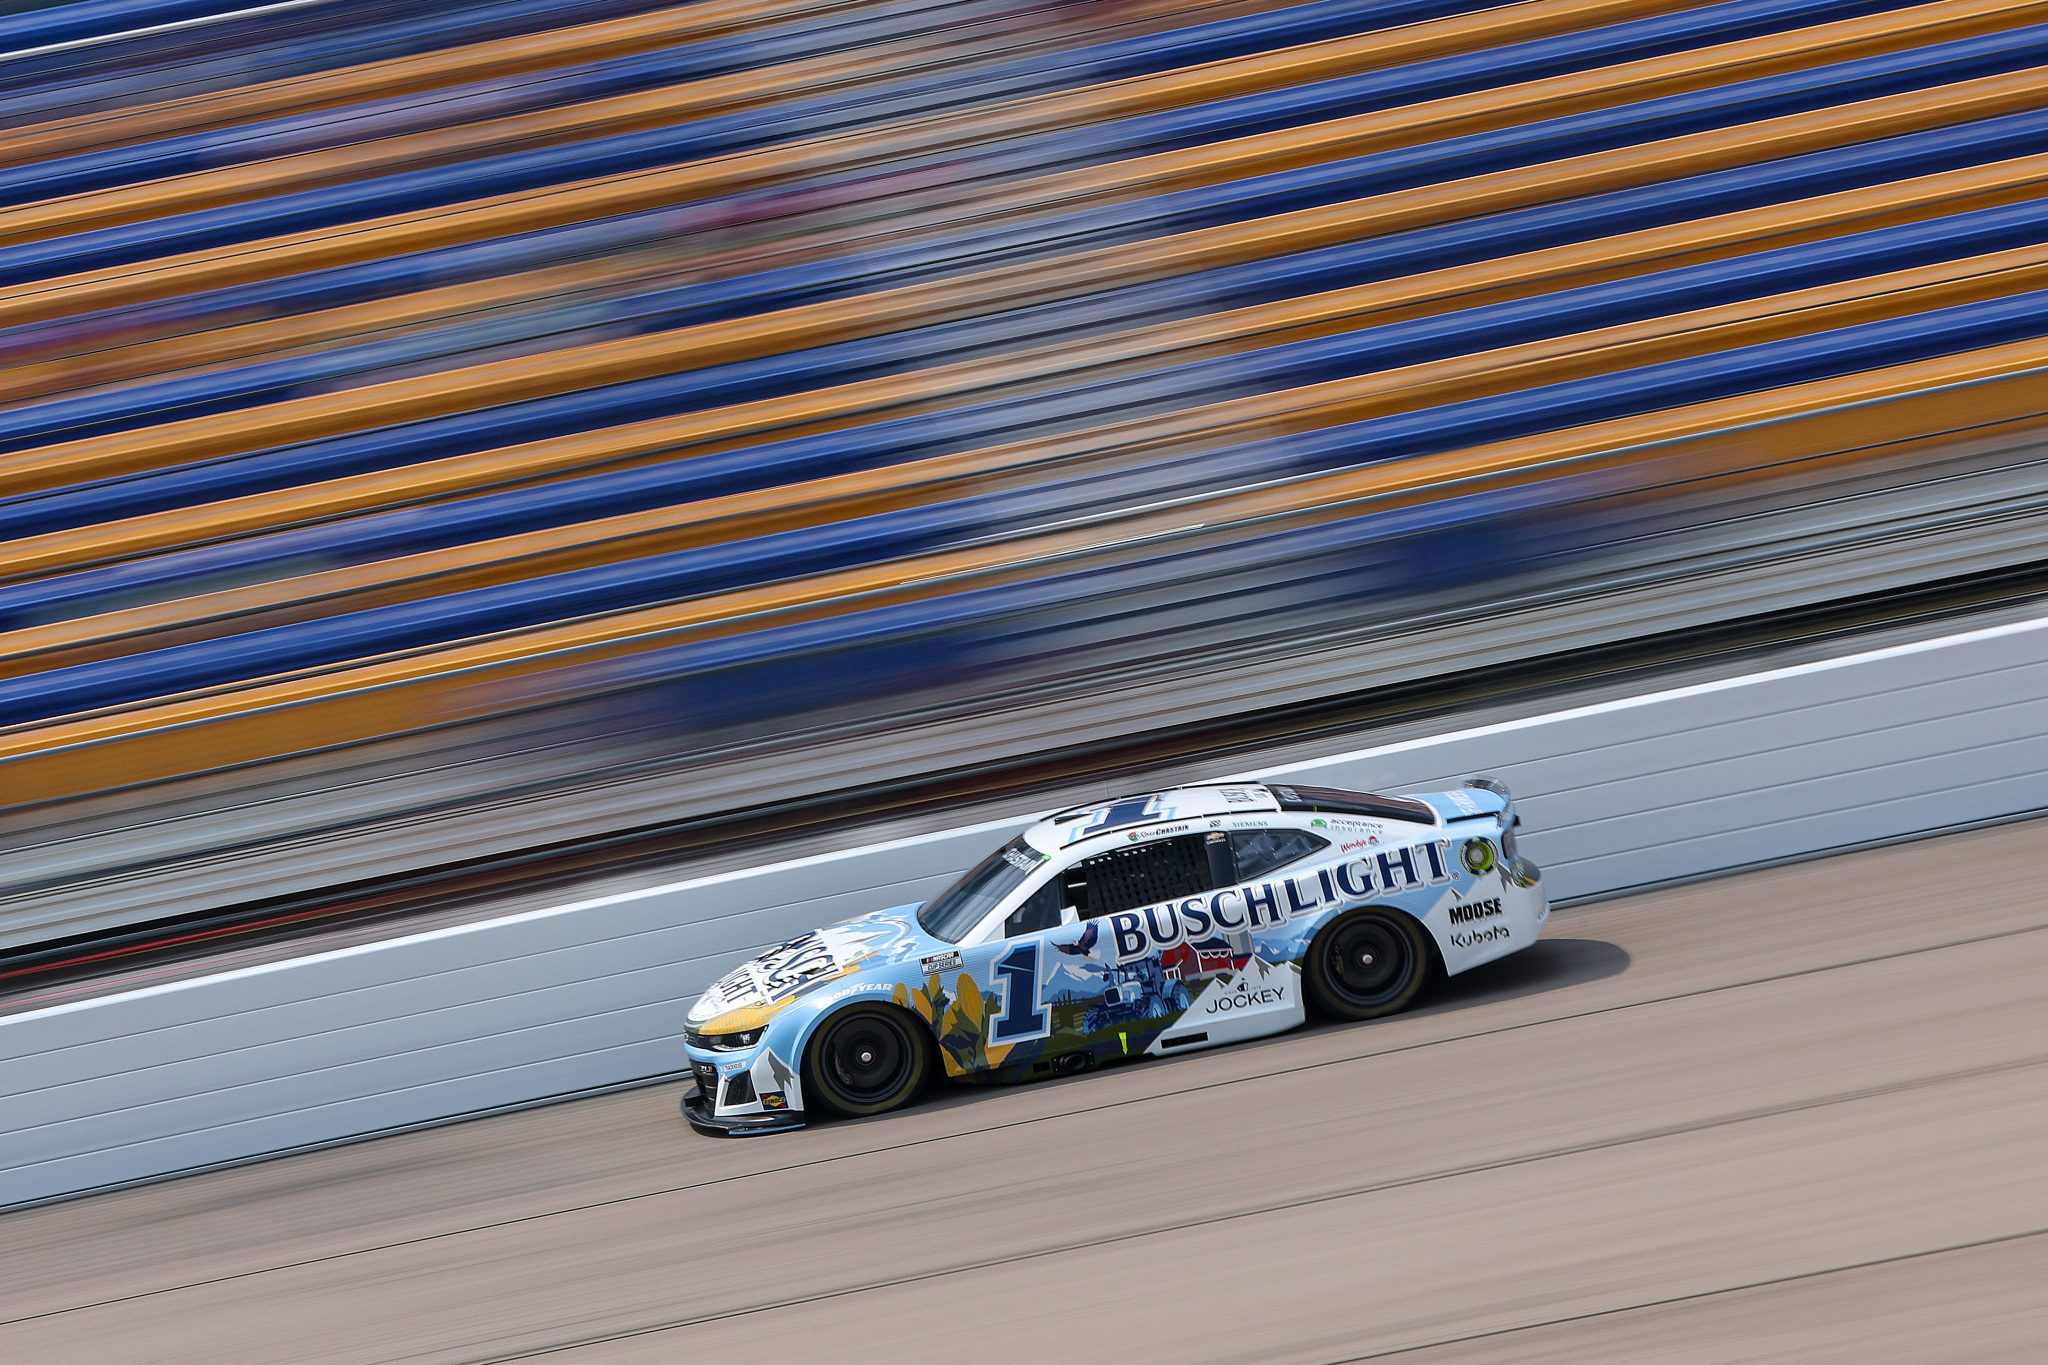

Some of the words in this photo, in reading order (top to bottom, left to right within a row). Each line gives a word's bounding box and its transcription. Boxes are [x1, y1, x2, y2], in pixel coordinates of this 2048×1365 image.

[1232, 820, 1268, 828] SIEMENS
[1330, 818, 1384, 829] acceptance
[1155, 824, 1189, 836] CHASTAIN
[1331, 825, 1384, 835] insurance
[1448, 898, 1502, 925] MOOSE
[1450, 925, 1510, 947] Kubota
[932, 951, 955, 962] NASCAR
[928, 963, 939, 971] CUP
[990, 937, 1051, 1047] 1
[1206, 987, 1284, 1014] JOCKEY
